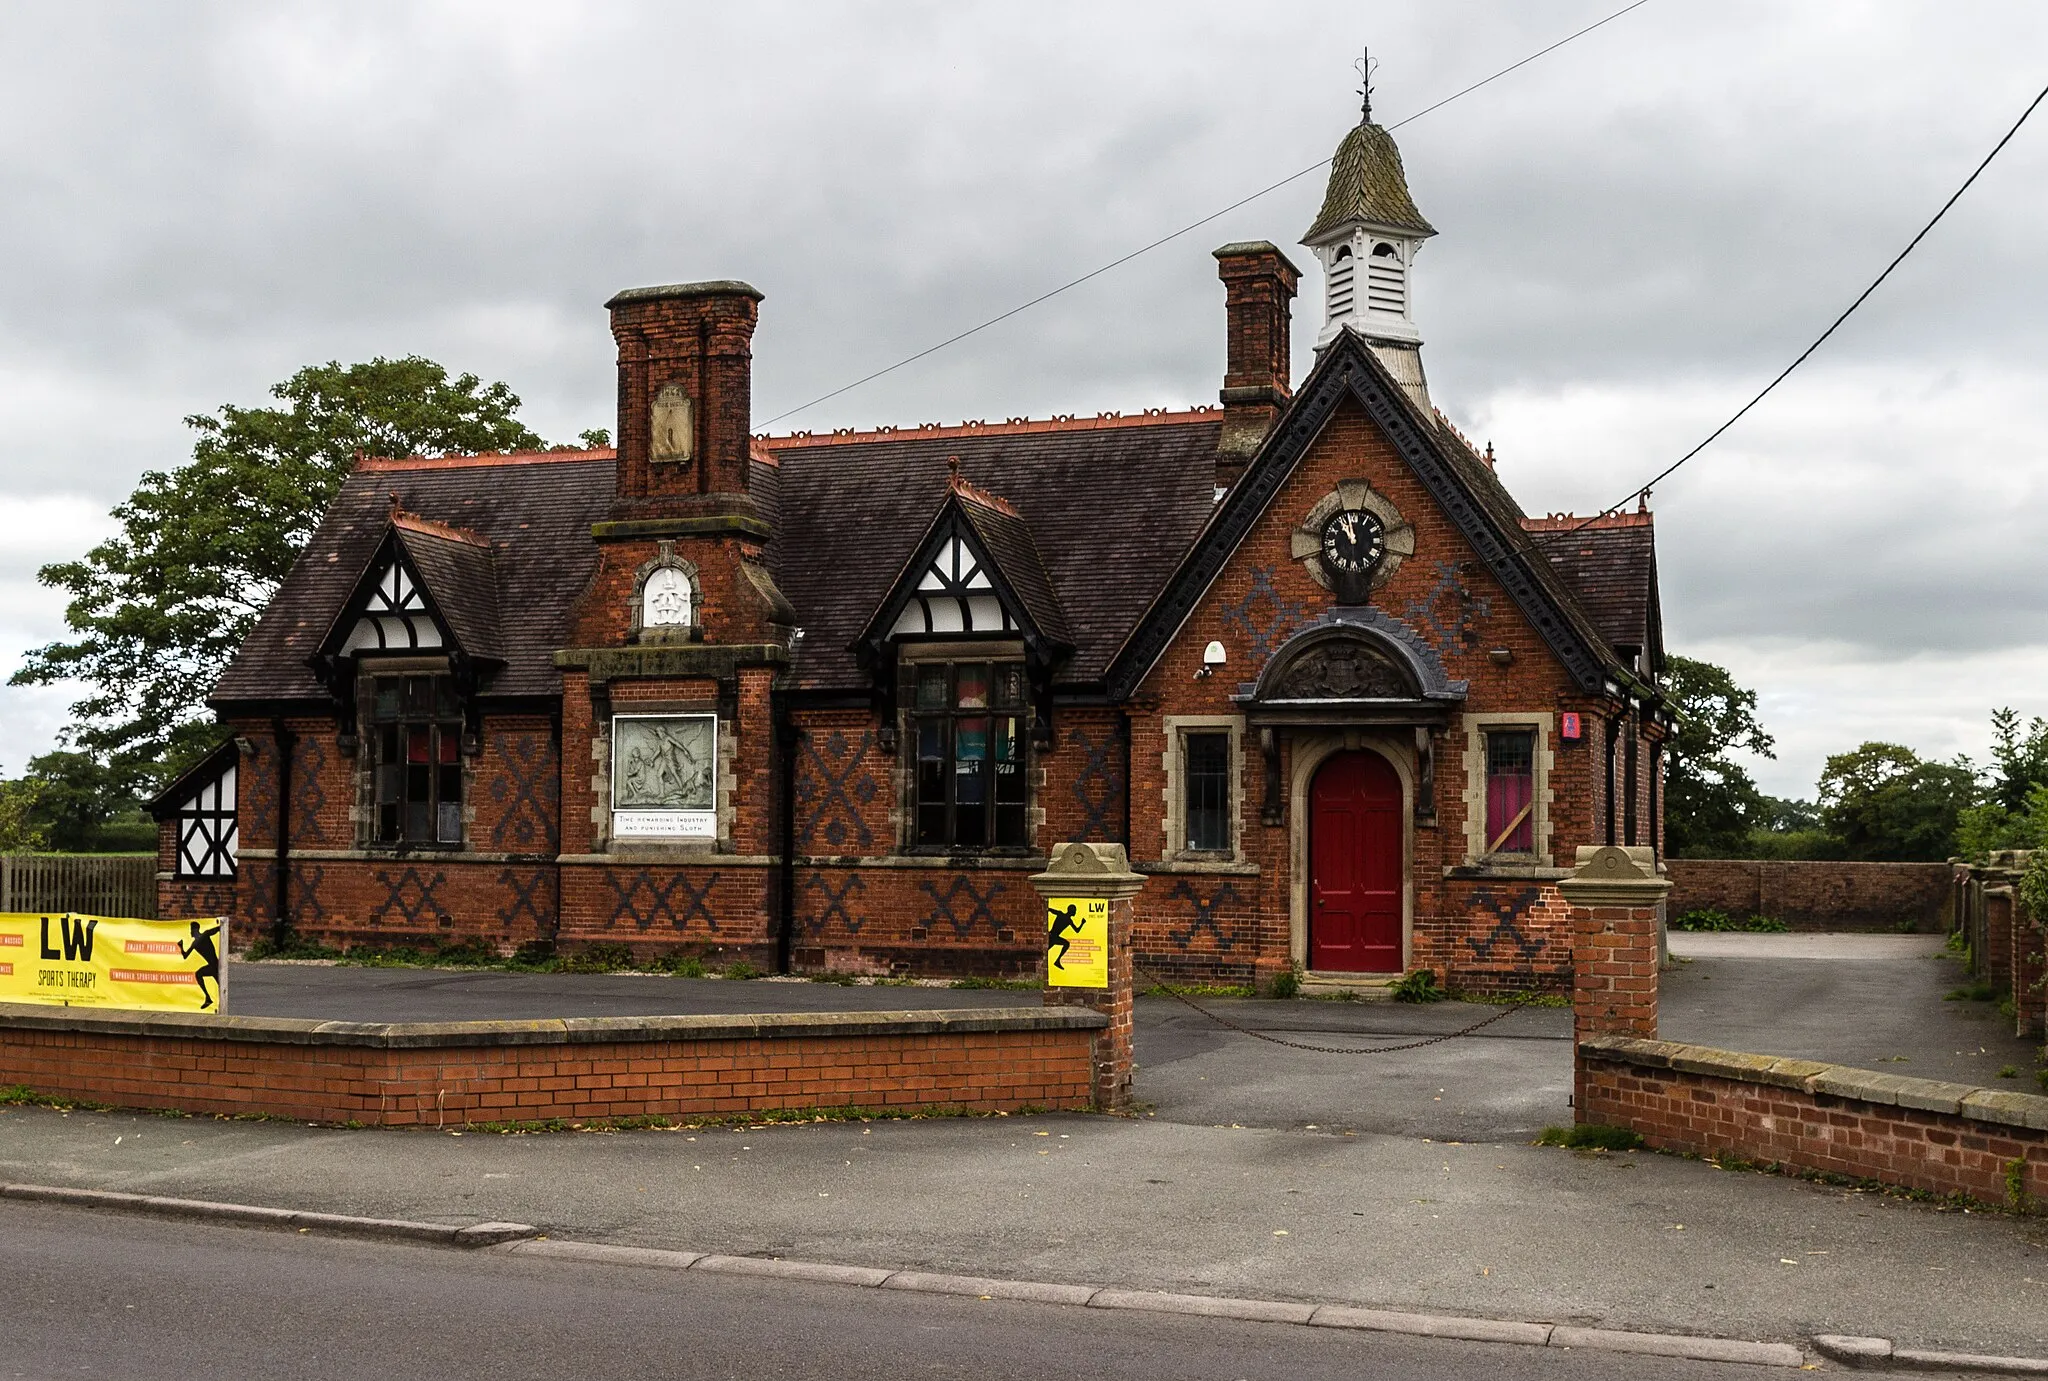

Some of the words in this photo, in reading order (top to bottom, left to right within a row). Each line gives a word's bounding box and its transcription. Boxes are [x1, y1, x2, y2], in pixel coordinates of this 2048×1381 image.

[1089, 902, 1105, 913] LW
[41, 917, 98, 961] LW
[38, 969, 64, 987] SPORTS
[67, 971, 97, 989] THERAPY
